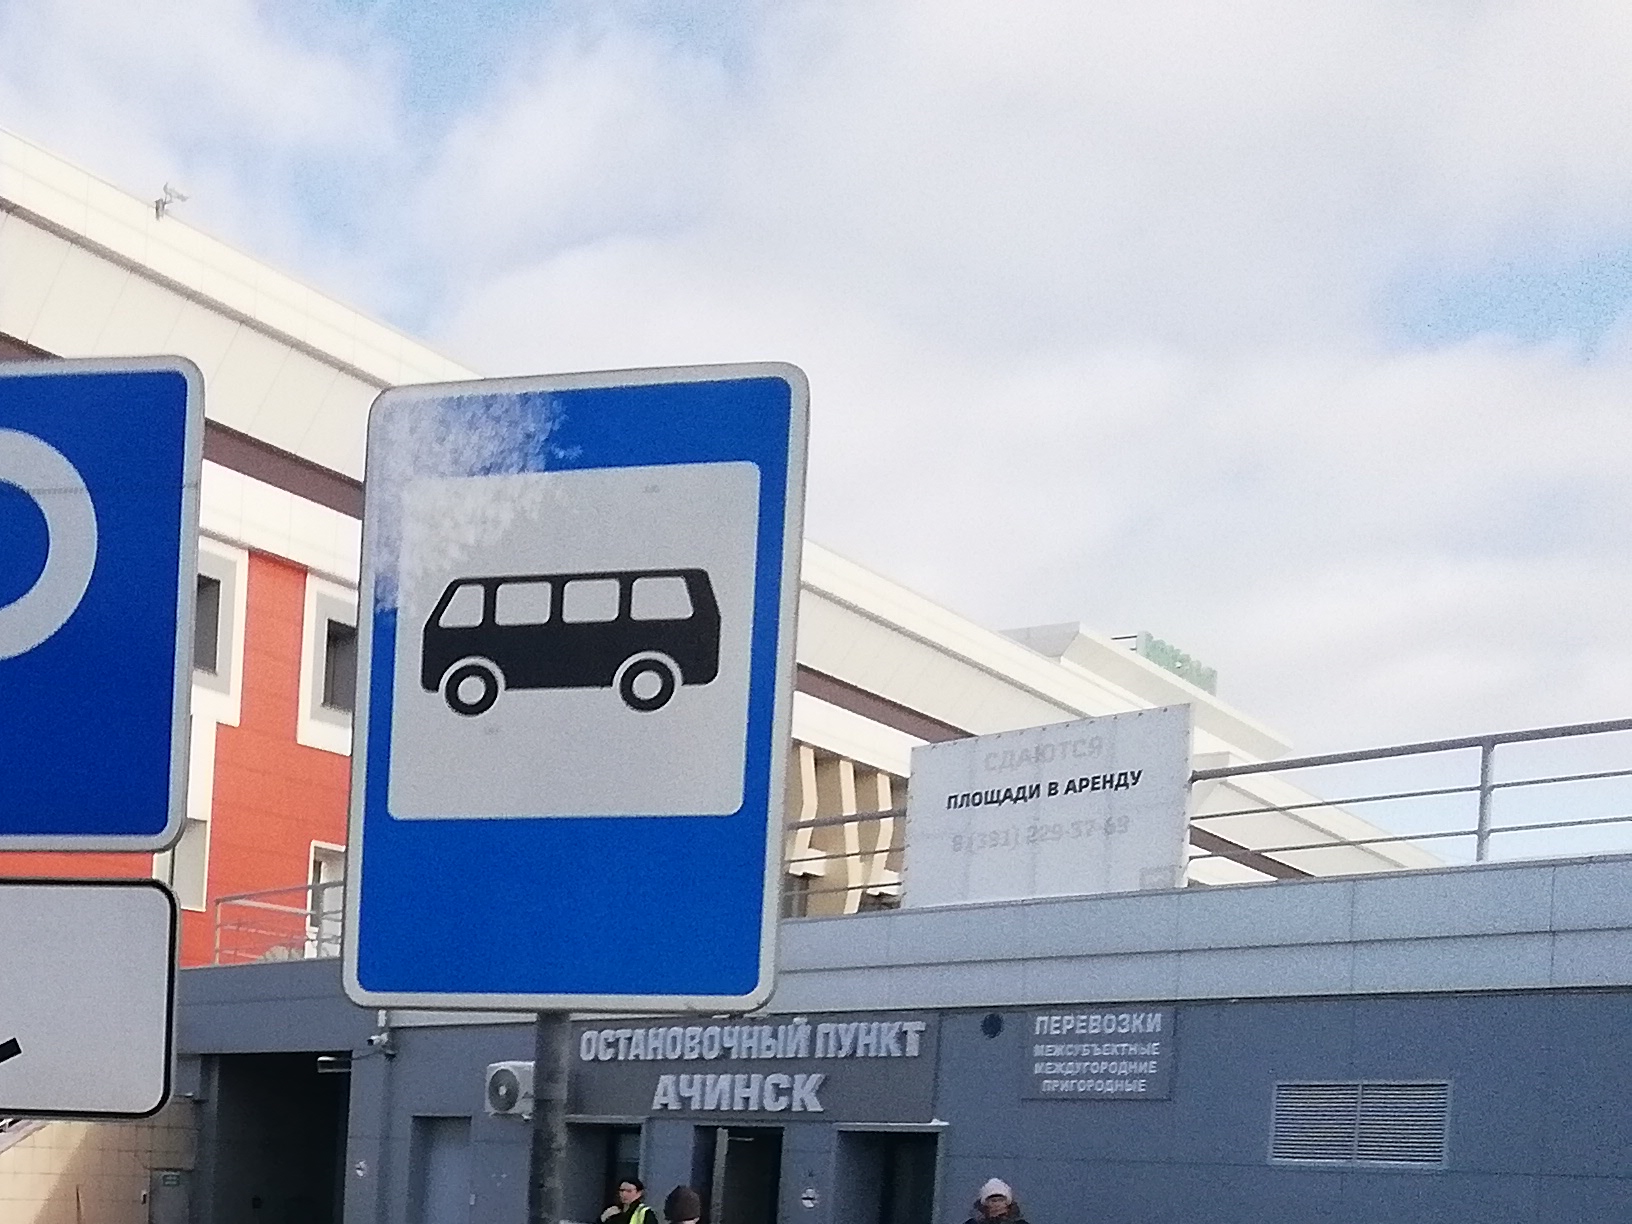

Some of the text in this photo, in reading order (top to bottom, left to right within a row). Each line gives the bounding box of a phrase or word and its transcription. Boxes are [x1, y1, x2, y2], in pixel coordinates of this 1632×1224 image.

[983, 735, 1104, 773] СДАЮТСЯ
[946, 769, 1143, 810] ПЛОЩАДИ В АРЕНДУ
[1034, 1012, 1163, 1035] ПЕРЕВОЗКИ
[579, 1016, 927, 1062] ОСТАНОВОЧНЫЙ ПУНКТ
[1033, 1042, 1161, 1057] МЕЖСУБЪЕКТНЫЕ
[1034, 1060, 1158, 1076] МЕЖДУГОРОДНИЕ
[651, 1073, 827, 1112] АЧИНСК
[1041, 1078, 1147, 1094] ПРИГОРОДНЫЕ
